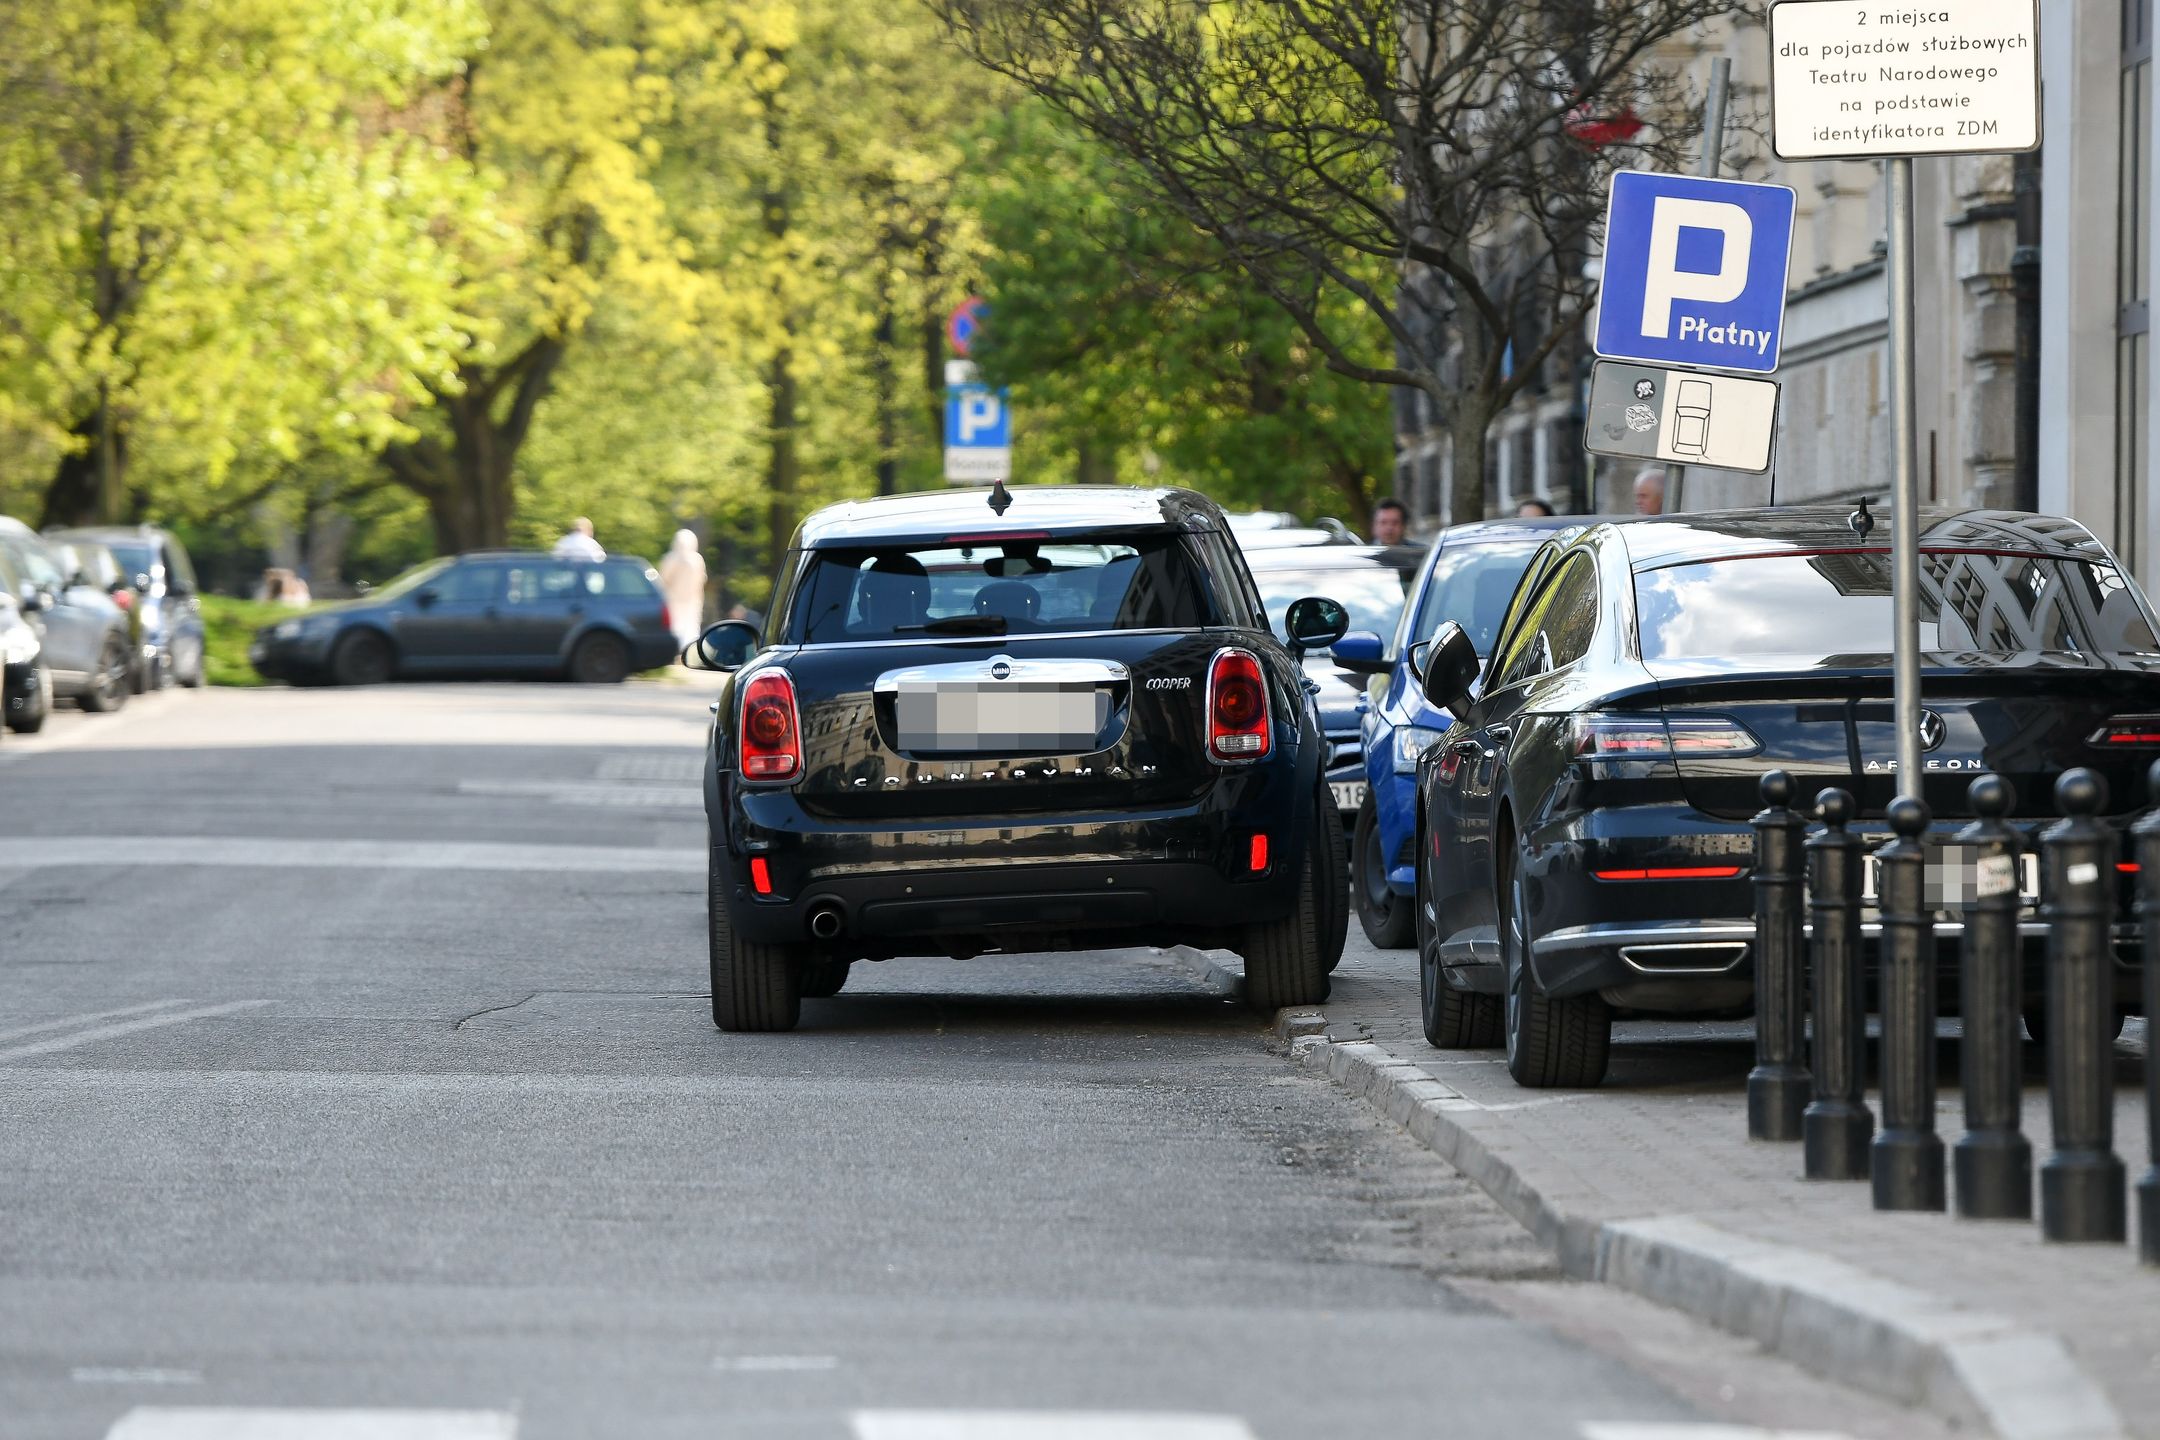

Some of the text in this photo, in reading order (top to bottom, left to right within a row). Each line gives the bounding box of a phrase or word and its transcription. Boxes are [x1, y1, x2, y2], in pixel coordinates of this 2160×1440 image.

[1857, 9, 1949, 27] 2 miejsca
[1780, 33, 2027, 60] dla pojazdów służbowych
[1809, 65, 1998, 85] Teatru Narodowego
[1840, 93, 1971, 115] na podstawie
[1813, 120, 1998, 144] identyfikatora ZDM
[1641, 196, 1753, 339] P
[1679, 316, 1772, 355] Płatny
[959, 390, 999, 442] P
[992, 667, 1010, 675] MINI
[1145, 677, 1191, 690] COOPER
[854, 765, 1157, 787] COUNTRYMAN
[1866, 759, 1982, 771] AREON
